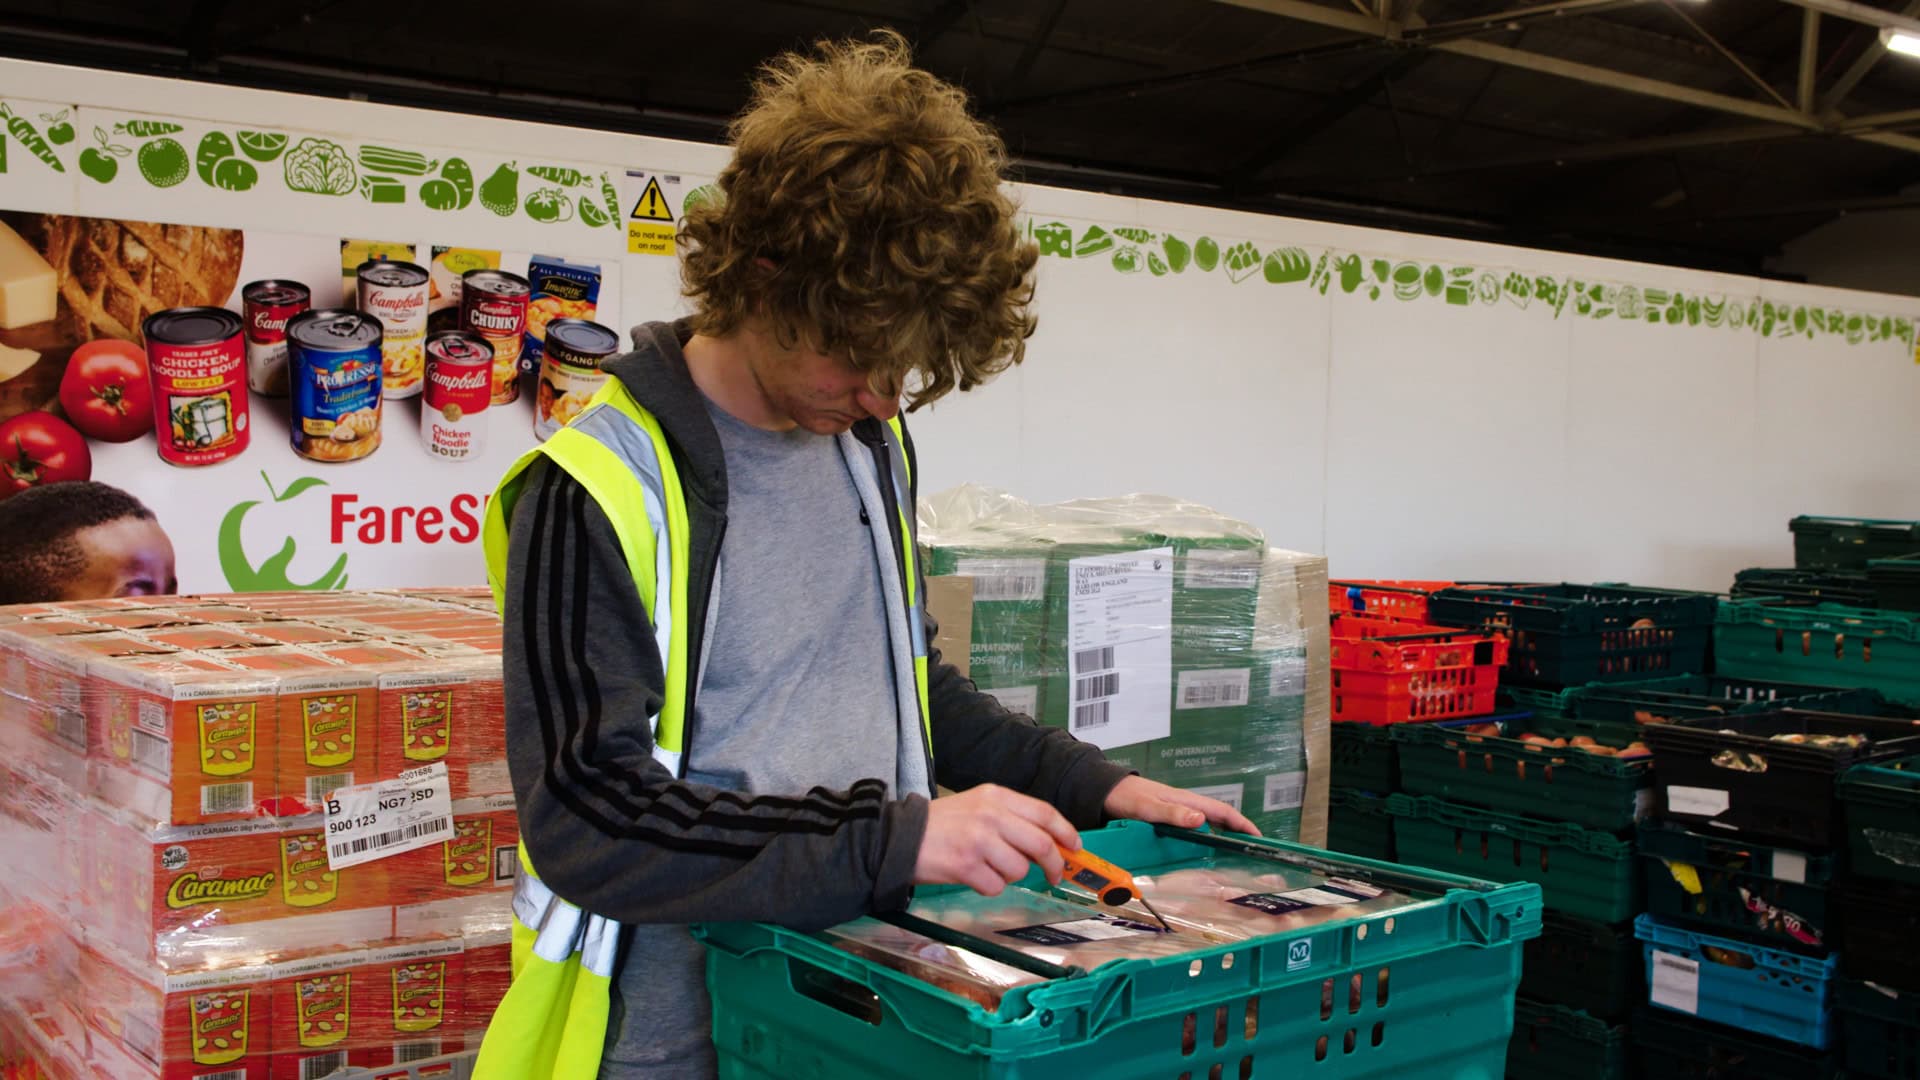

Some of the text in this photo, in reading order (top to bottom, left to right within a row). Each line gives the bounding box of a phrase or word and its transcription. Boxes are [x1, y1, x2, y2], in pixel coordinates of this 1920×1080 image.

[629, 230, 641, 238] Do
[657, 233, 674, 241] walk
[471, 308, 520, 332] CHUNKY
[152, 356, 242, 379] NOODLE SOUP
[162, 353, 230, 369] CHICKEN
[432, 422, 471, 441] Chicken
[432, 433, 470, 448] Noodle
[431, 442, 469, 458] SOUP
[330, 493, 485, 544] FareS
[970, 643, 1024, 653] ERNATIONAL
[1174, 744, 1231, 755] INTERNATIONAL
[1175, 759, 1200, 768] FOODS
[328, 800, 341, 815] B
[378, 797, 406, 812] NG7
[202, 826, 238, 836] CARAMAC
[253, 822, 275, 831] Pouch
[329, 814, 377, 834] 900 123
[167, 872, 276, 909] Caramac
